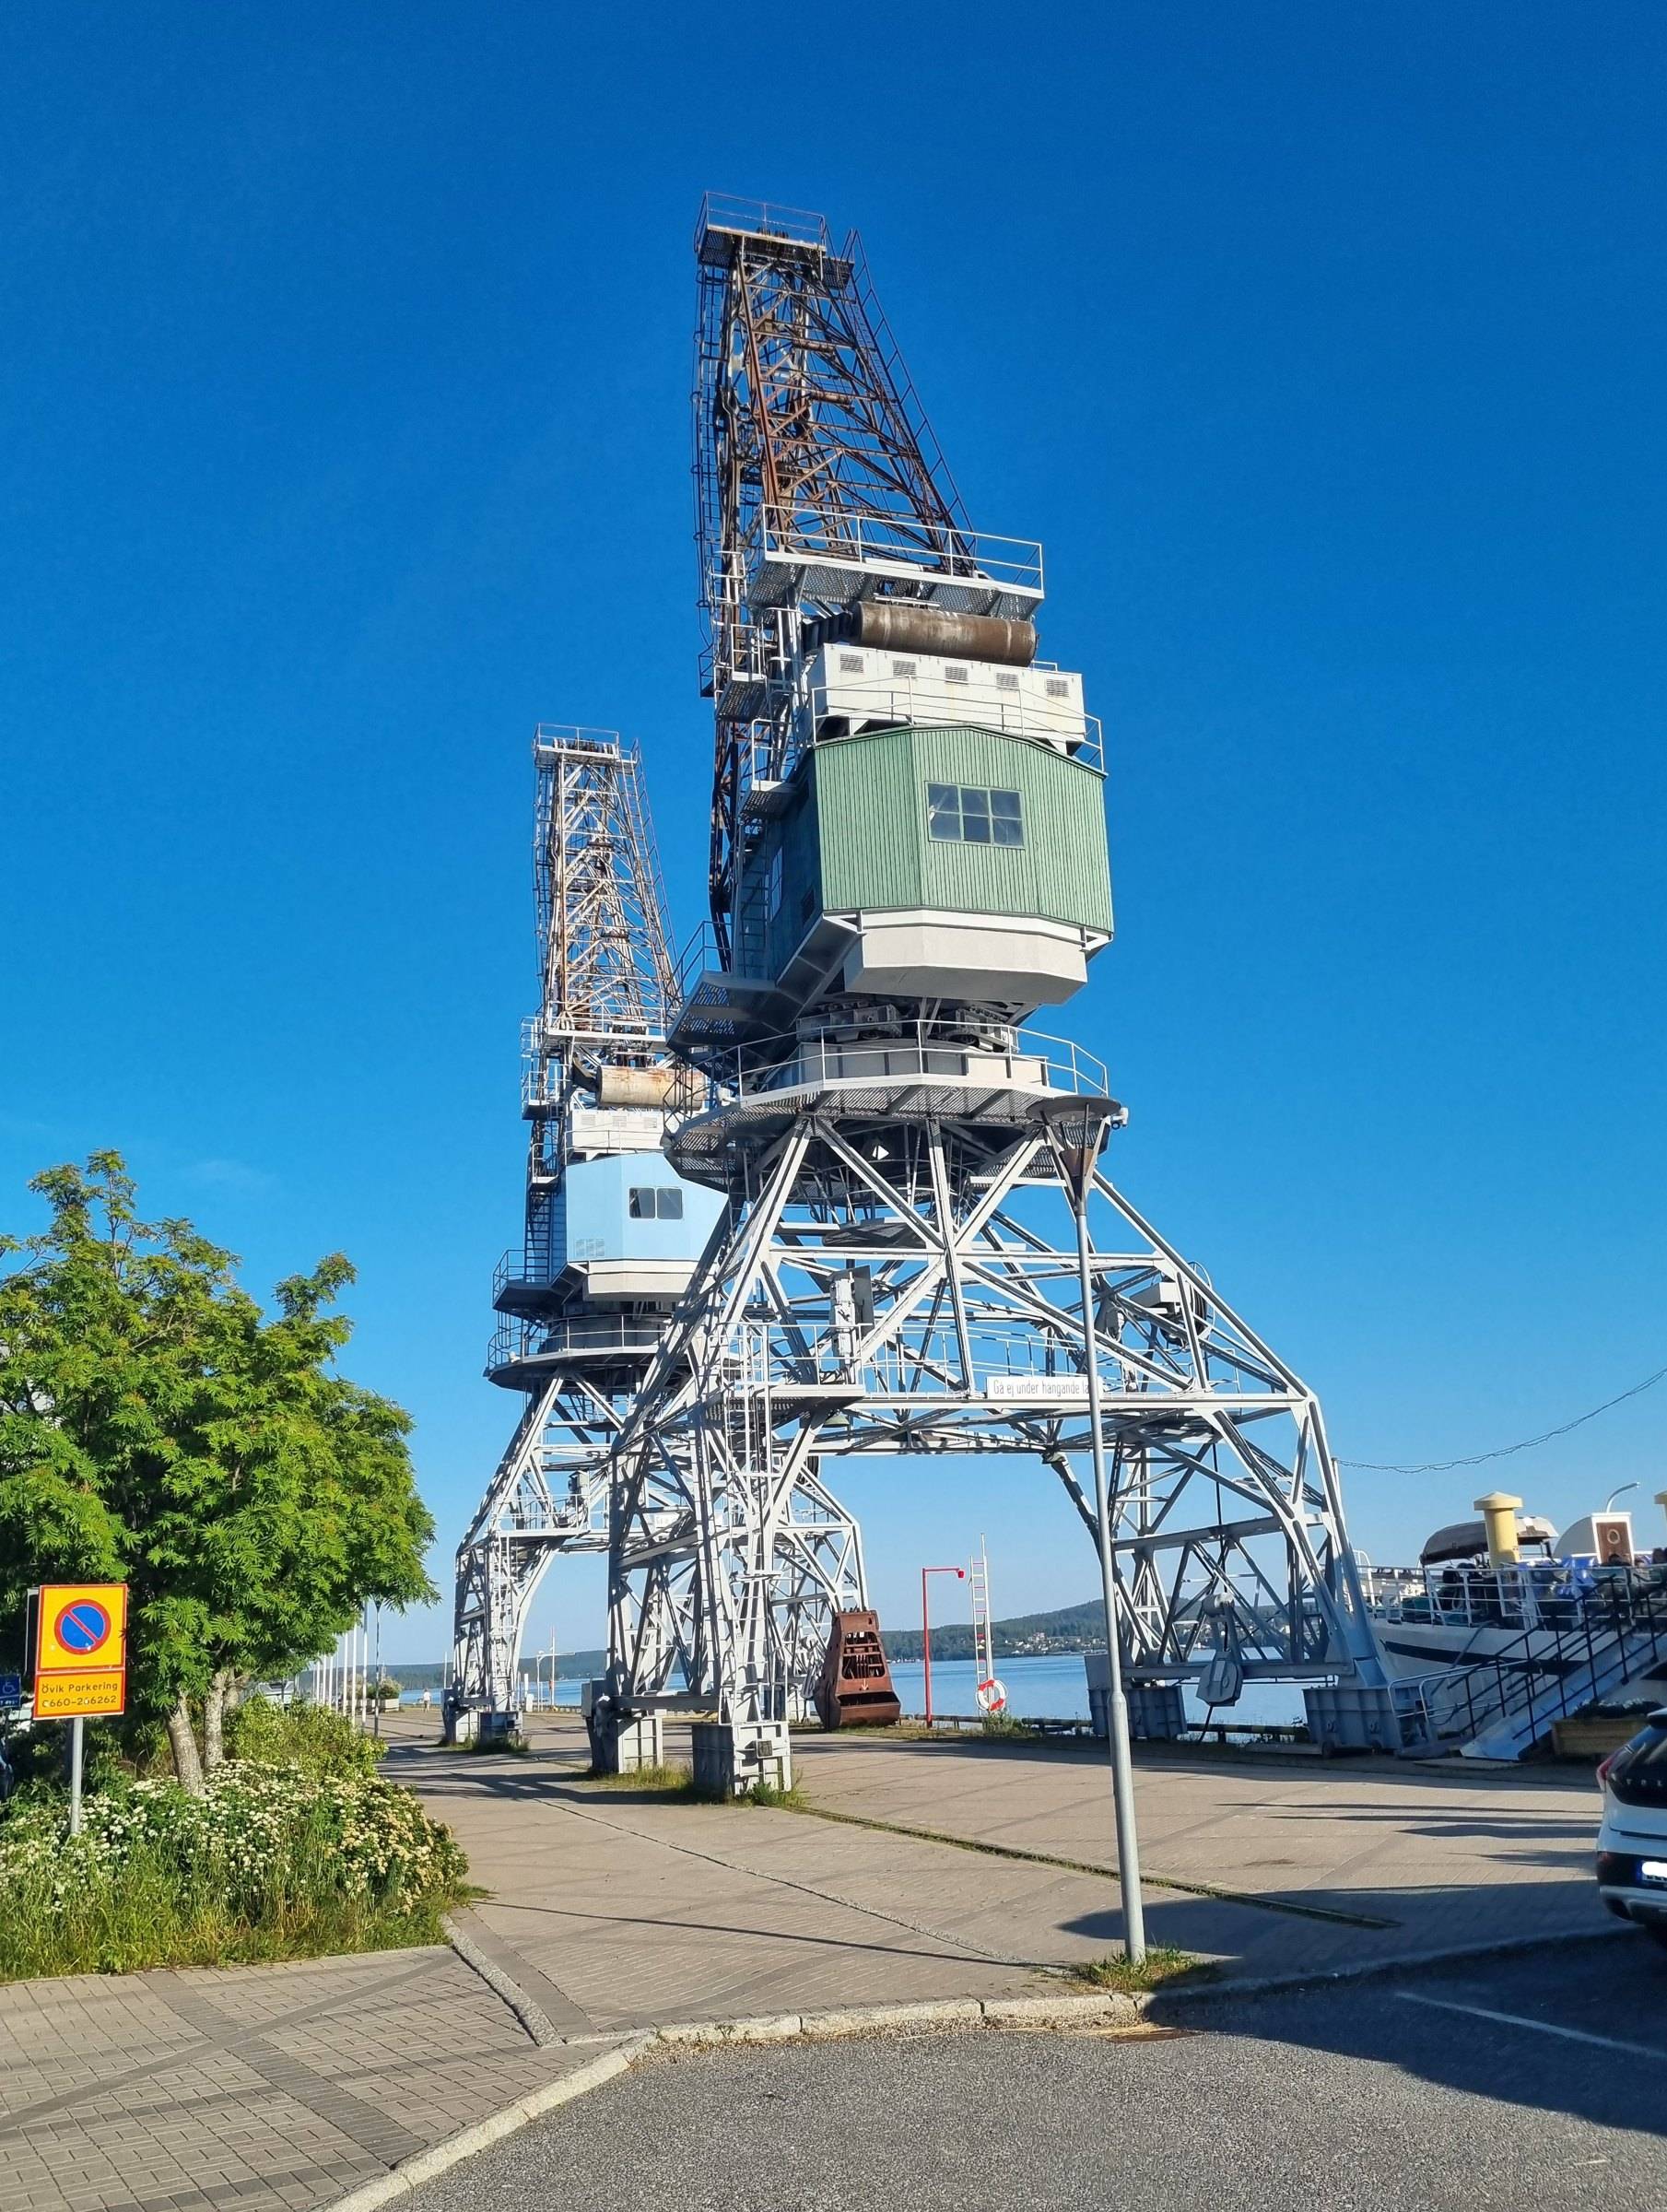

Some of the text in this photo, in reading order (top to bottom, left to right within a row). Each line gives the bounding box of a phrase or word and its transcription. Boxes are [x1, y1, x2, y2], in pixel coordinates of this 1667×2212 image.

[1016, 1381, 1039, 1394] under
[41, 1681, 118, 1694] Övik Parkering
